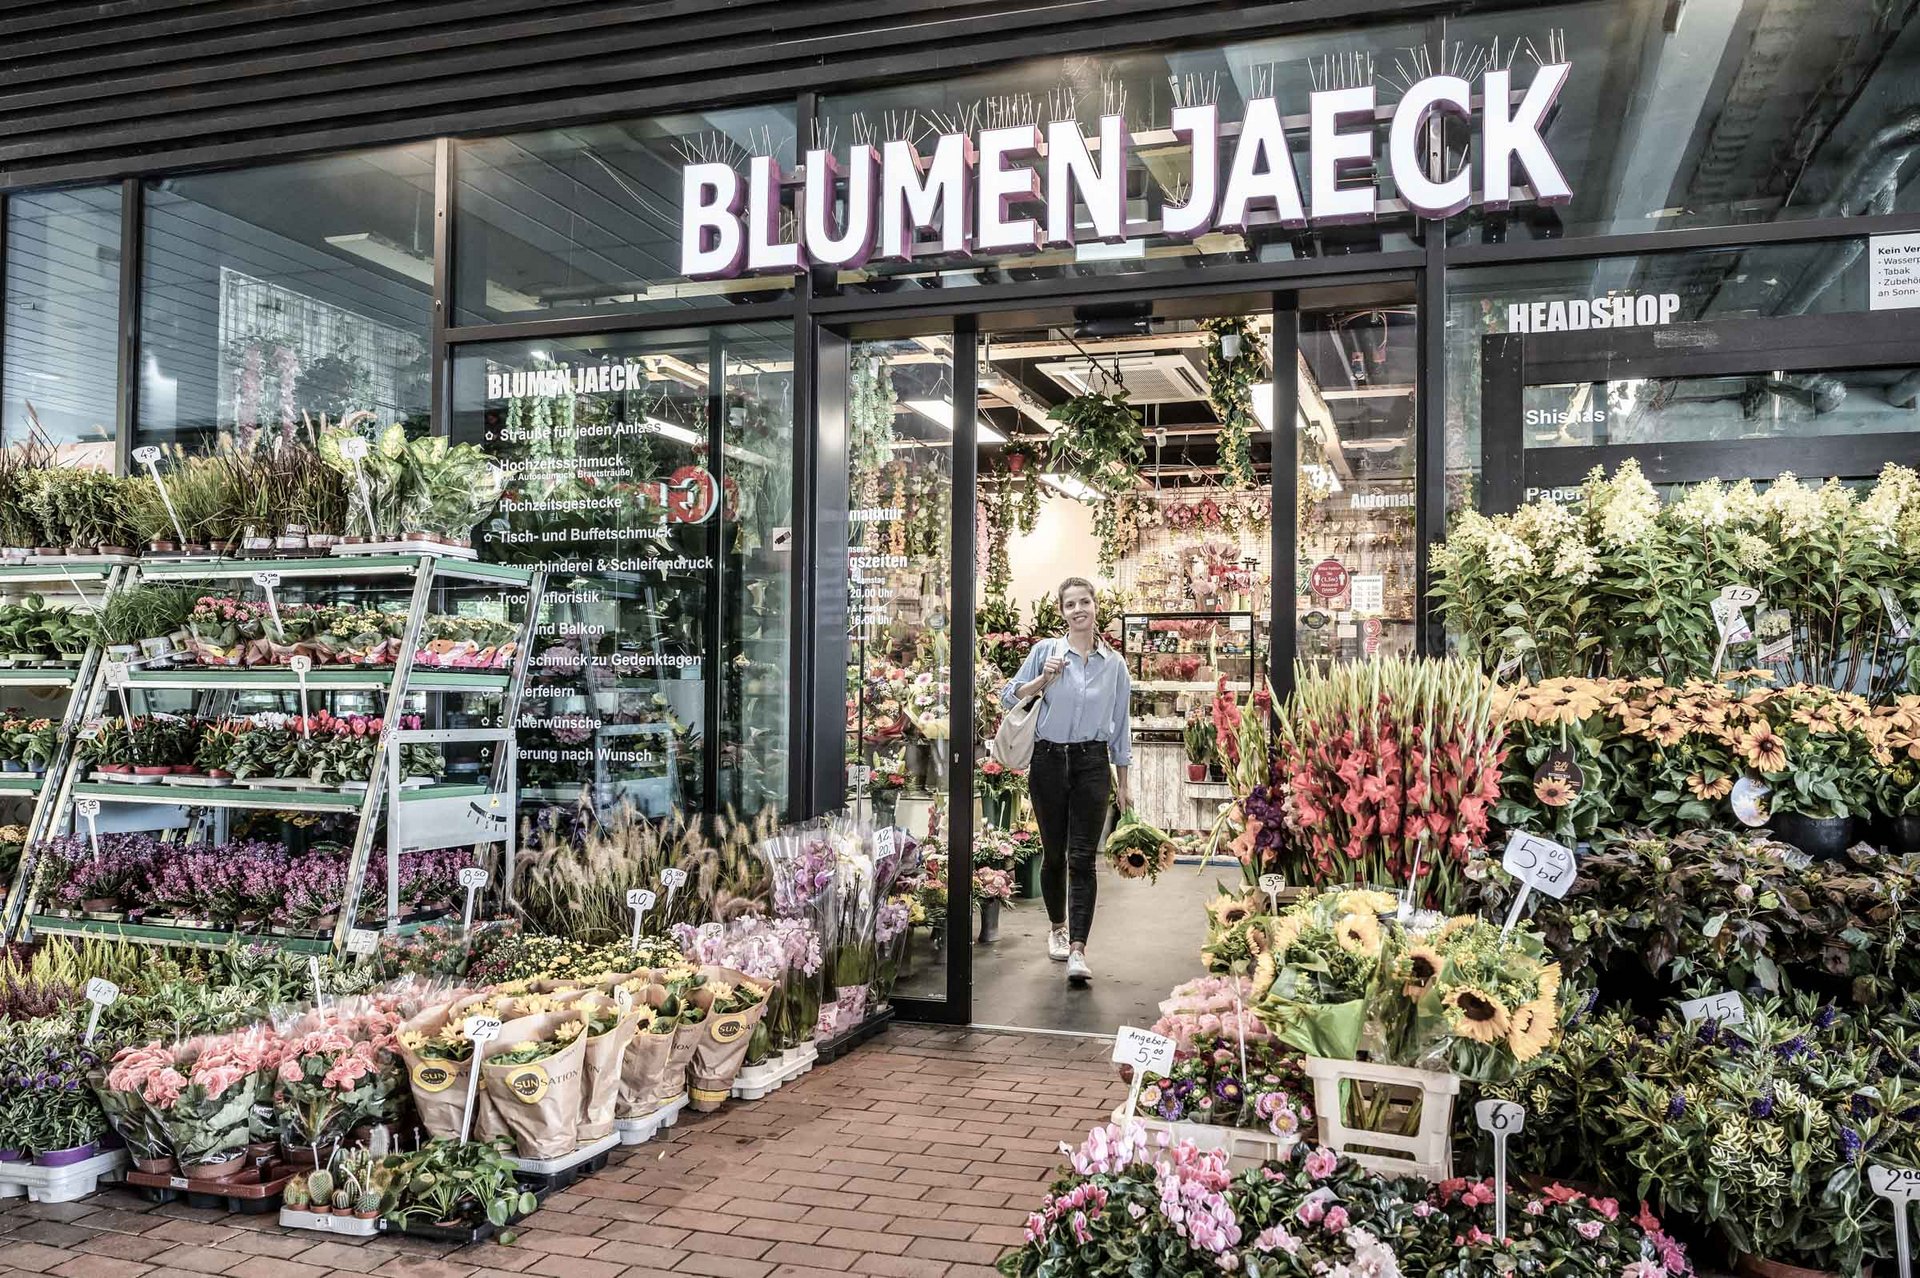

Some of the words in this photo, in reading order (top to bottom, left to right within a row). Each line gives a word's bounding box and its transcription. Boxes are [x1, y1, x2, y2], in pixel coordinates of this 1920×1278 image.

[681, 113, 1127, 278] BLUMEN
[1161, 61, 1573, 239] JAECK
[1878, 247, 1901, 255] Kein
[1884, 267, 1911, 275] Tabak
[1892, 288, 1919, 297] Sonn-
[1508, 293, 1680, 333] HEADSHOP
[488, 369, 571, 399] BLUMEN
[577, 363, 641, 394] JAECK
[500, 427, 551, 442] Sträuße
[553, 425, 575, 439] für
[575, 423, 613, 440] jeden
[615, 420, 662, 438] Anlass
[500, 455, 624, 472] Hochzeitsschmuck
[577, 467, 633, 479] Brautsträuße)
[499, 495, 623, 513] Hochzeitsgestecke
[499, 530, 539, 544] Tisch-
[541, 528, 568, 542] und
[570, 525, 672, 541] Buffetschmuck
[597, 559, 607, 572] &
[610, 555, 713, 571] Schleifendruck
[850, 555, 907, 569] gszeiten
[498, 590, 600, 605] Trocnfloristik
[559, 621, 605, 635] Balkon
[591, 653, 606, 666] zu
[611, 651, 702, 669] Gedenktagen
[497, 714, 602, 729] Snderwünsche
[561, 748, 593, 761] nach
[597, 747, 652, 762] Wunsch
[1129, 1031, 1168, 1046] Angebot
[421, 1072, 446, 1080] SUN
[515, 1079, 539, 1090] SUN
